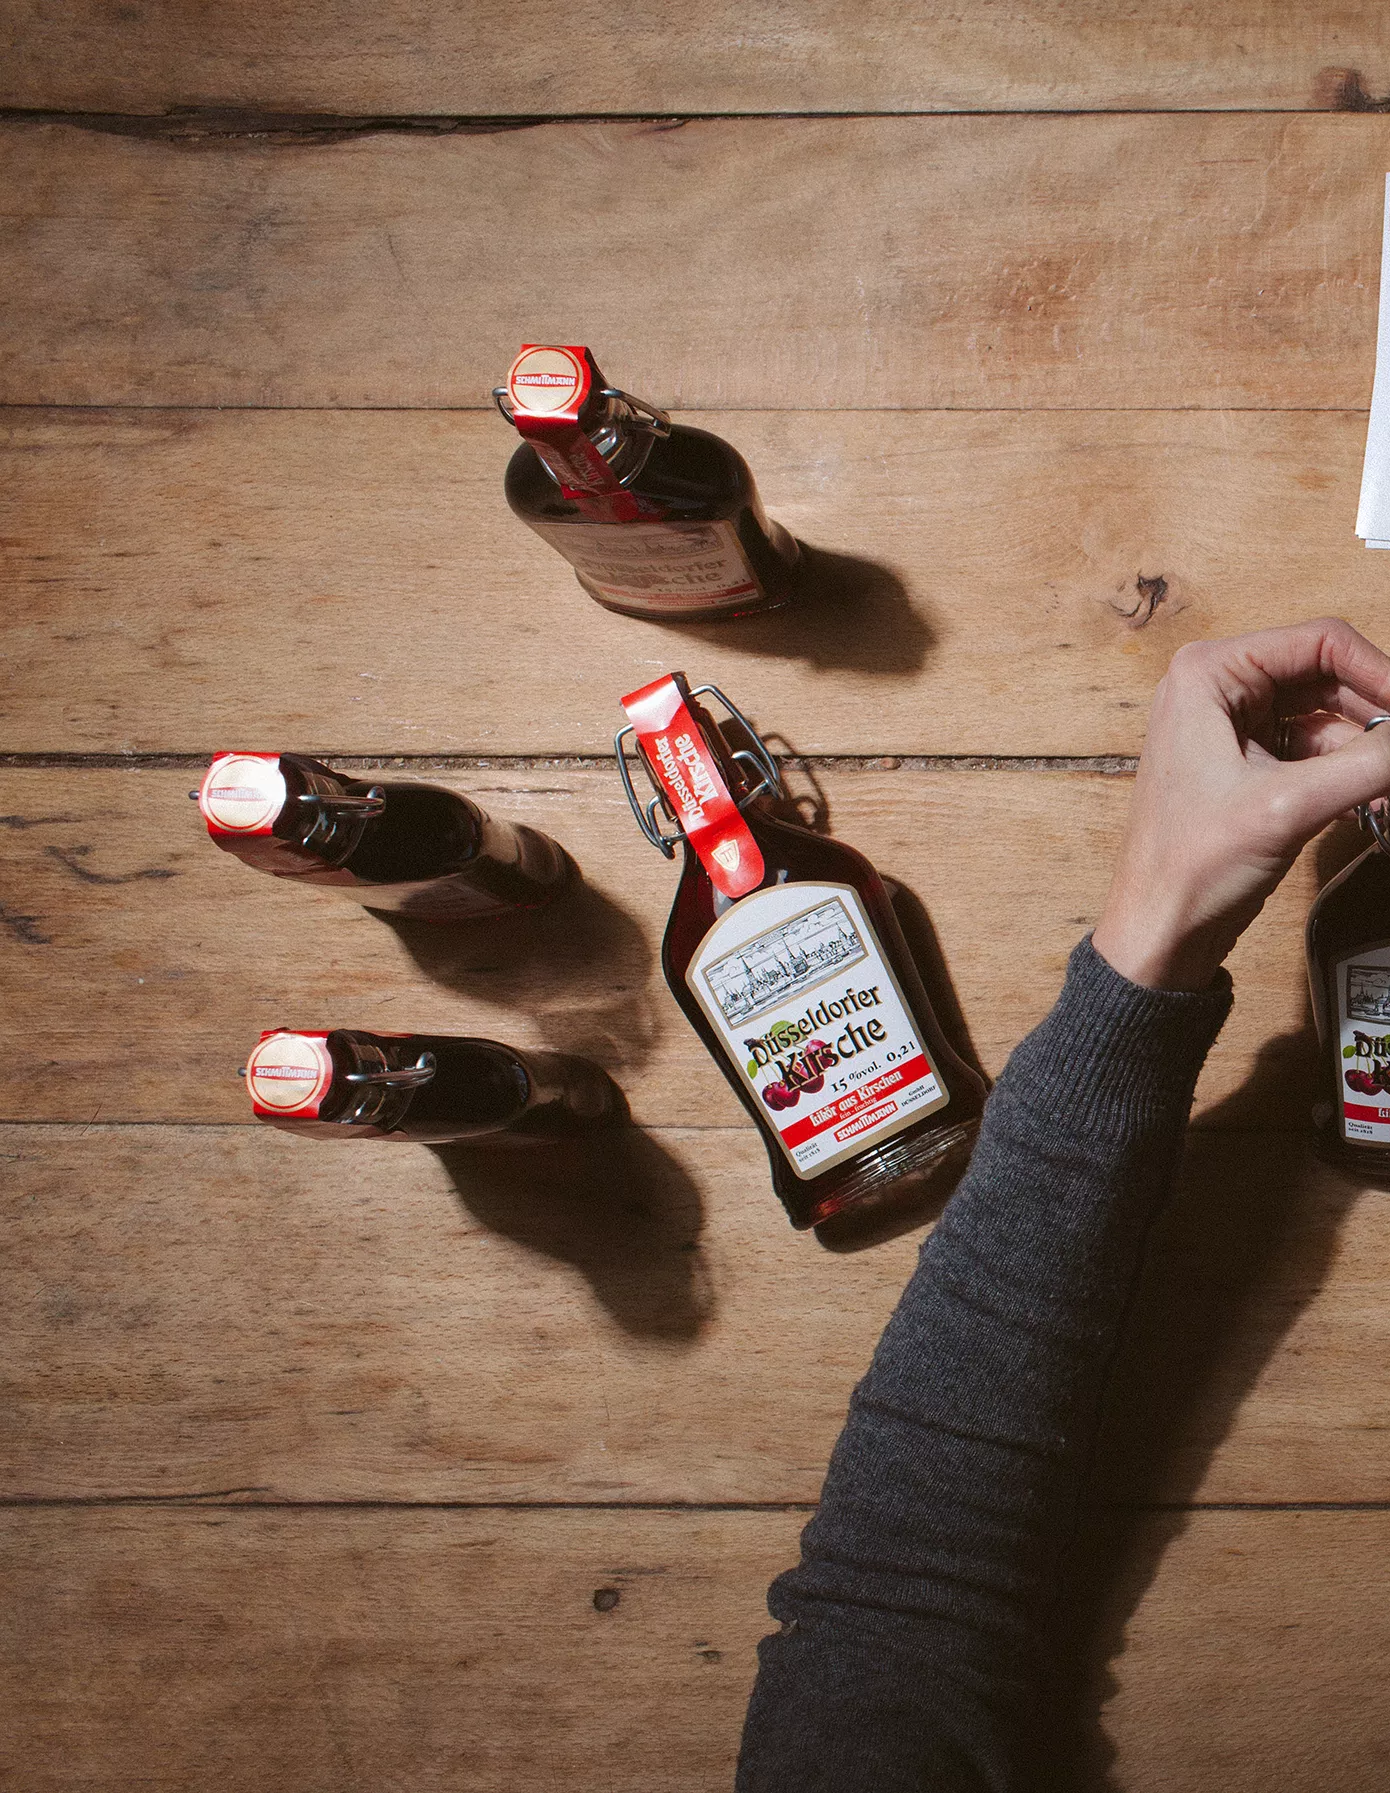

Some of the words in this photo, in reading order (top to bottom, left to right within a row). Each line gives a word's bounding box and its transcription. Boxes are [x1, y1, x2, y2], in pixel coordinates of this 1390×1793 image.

[515, 374, 576, 386] SCHMITTMANN
[655, 736, 705, 822] Düsseldorfer
[674, 733, 719, 805] Kirsche
[749, 985, 883, 1068] Düsseldorfer
[775, 1018, 888, 1092] Kirsche
[831, 1078, 848, 1093] 15
[838, 1096, 859, 1111] aus
[856, 1071, 903, 1100] Kirschen
[837, 1103, 896, 1141] SCHMITTMANN
